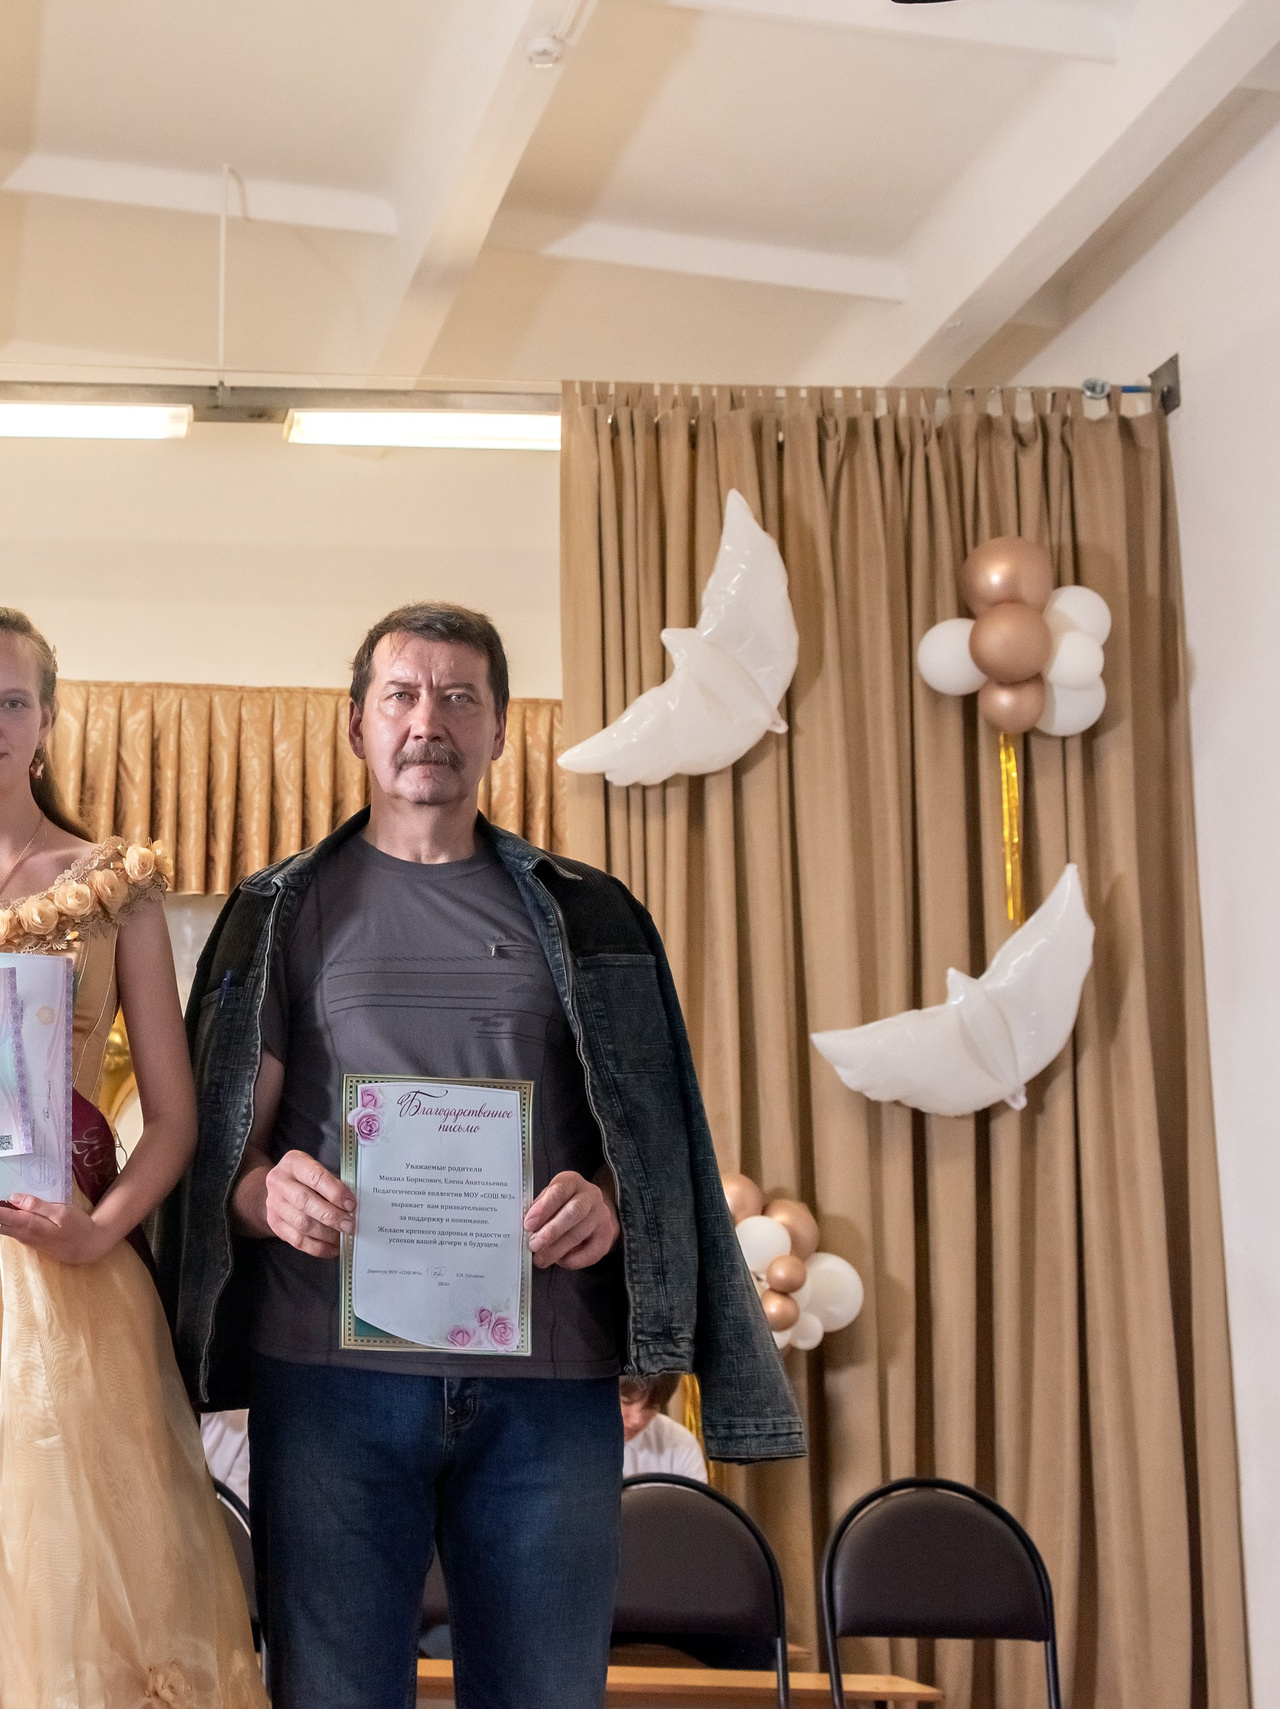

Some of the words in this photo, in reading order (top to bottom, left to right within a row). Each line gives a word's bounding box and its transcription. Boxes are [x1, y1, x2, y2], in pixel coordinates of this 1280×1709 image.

[397, 1090, 514, 1122] Благодарственное
[438, 1122, 480, 1133] письмо
[405, 1162, 446, 1171] Уважаемые
[406, 1176, 444, 1184] Борисович,
[372, 1188, 426, 1196] Педагогический
[441, 1204, 498, 1212] признательность
